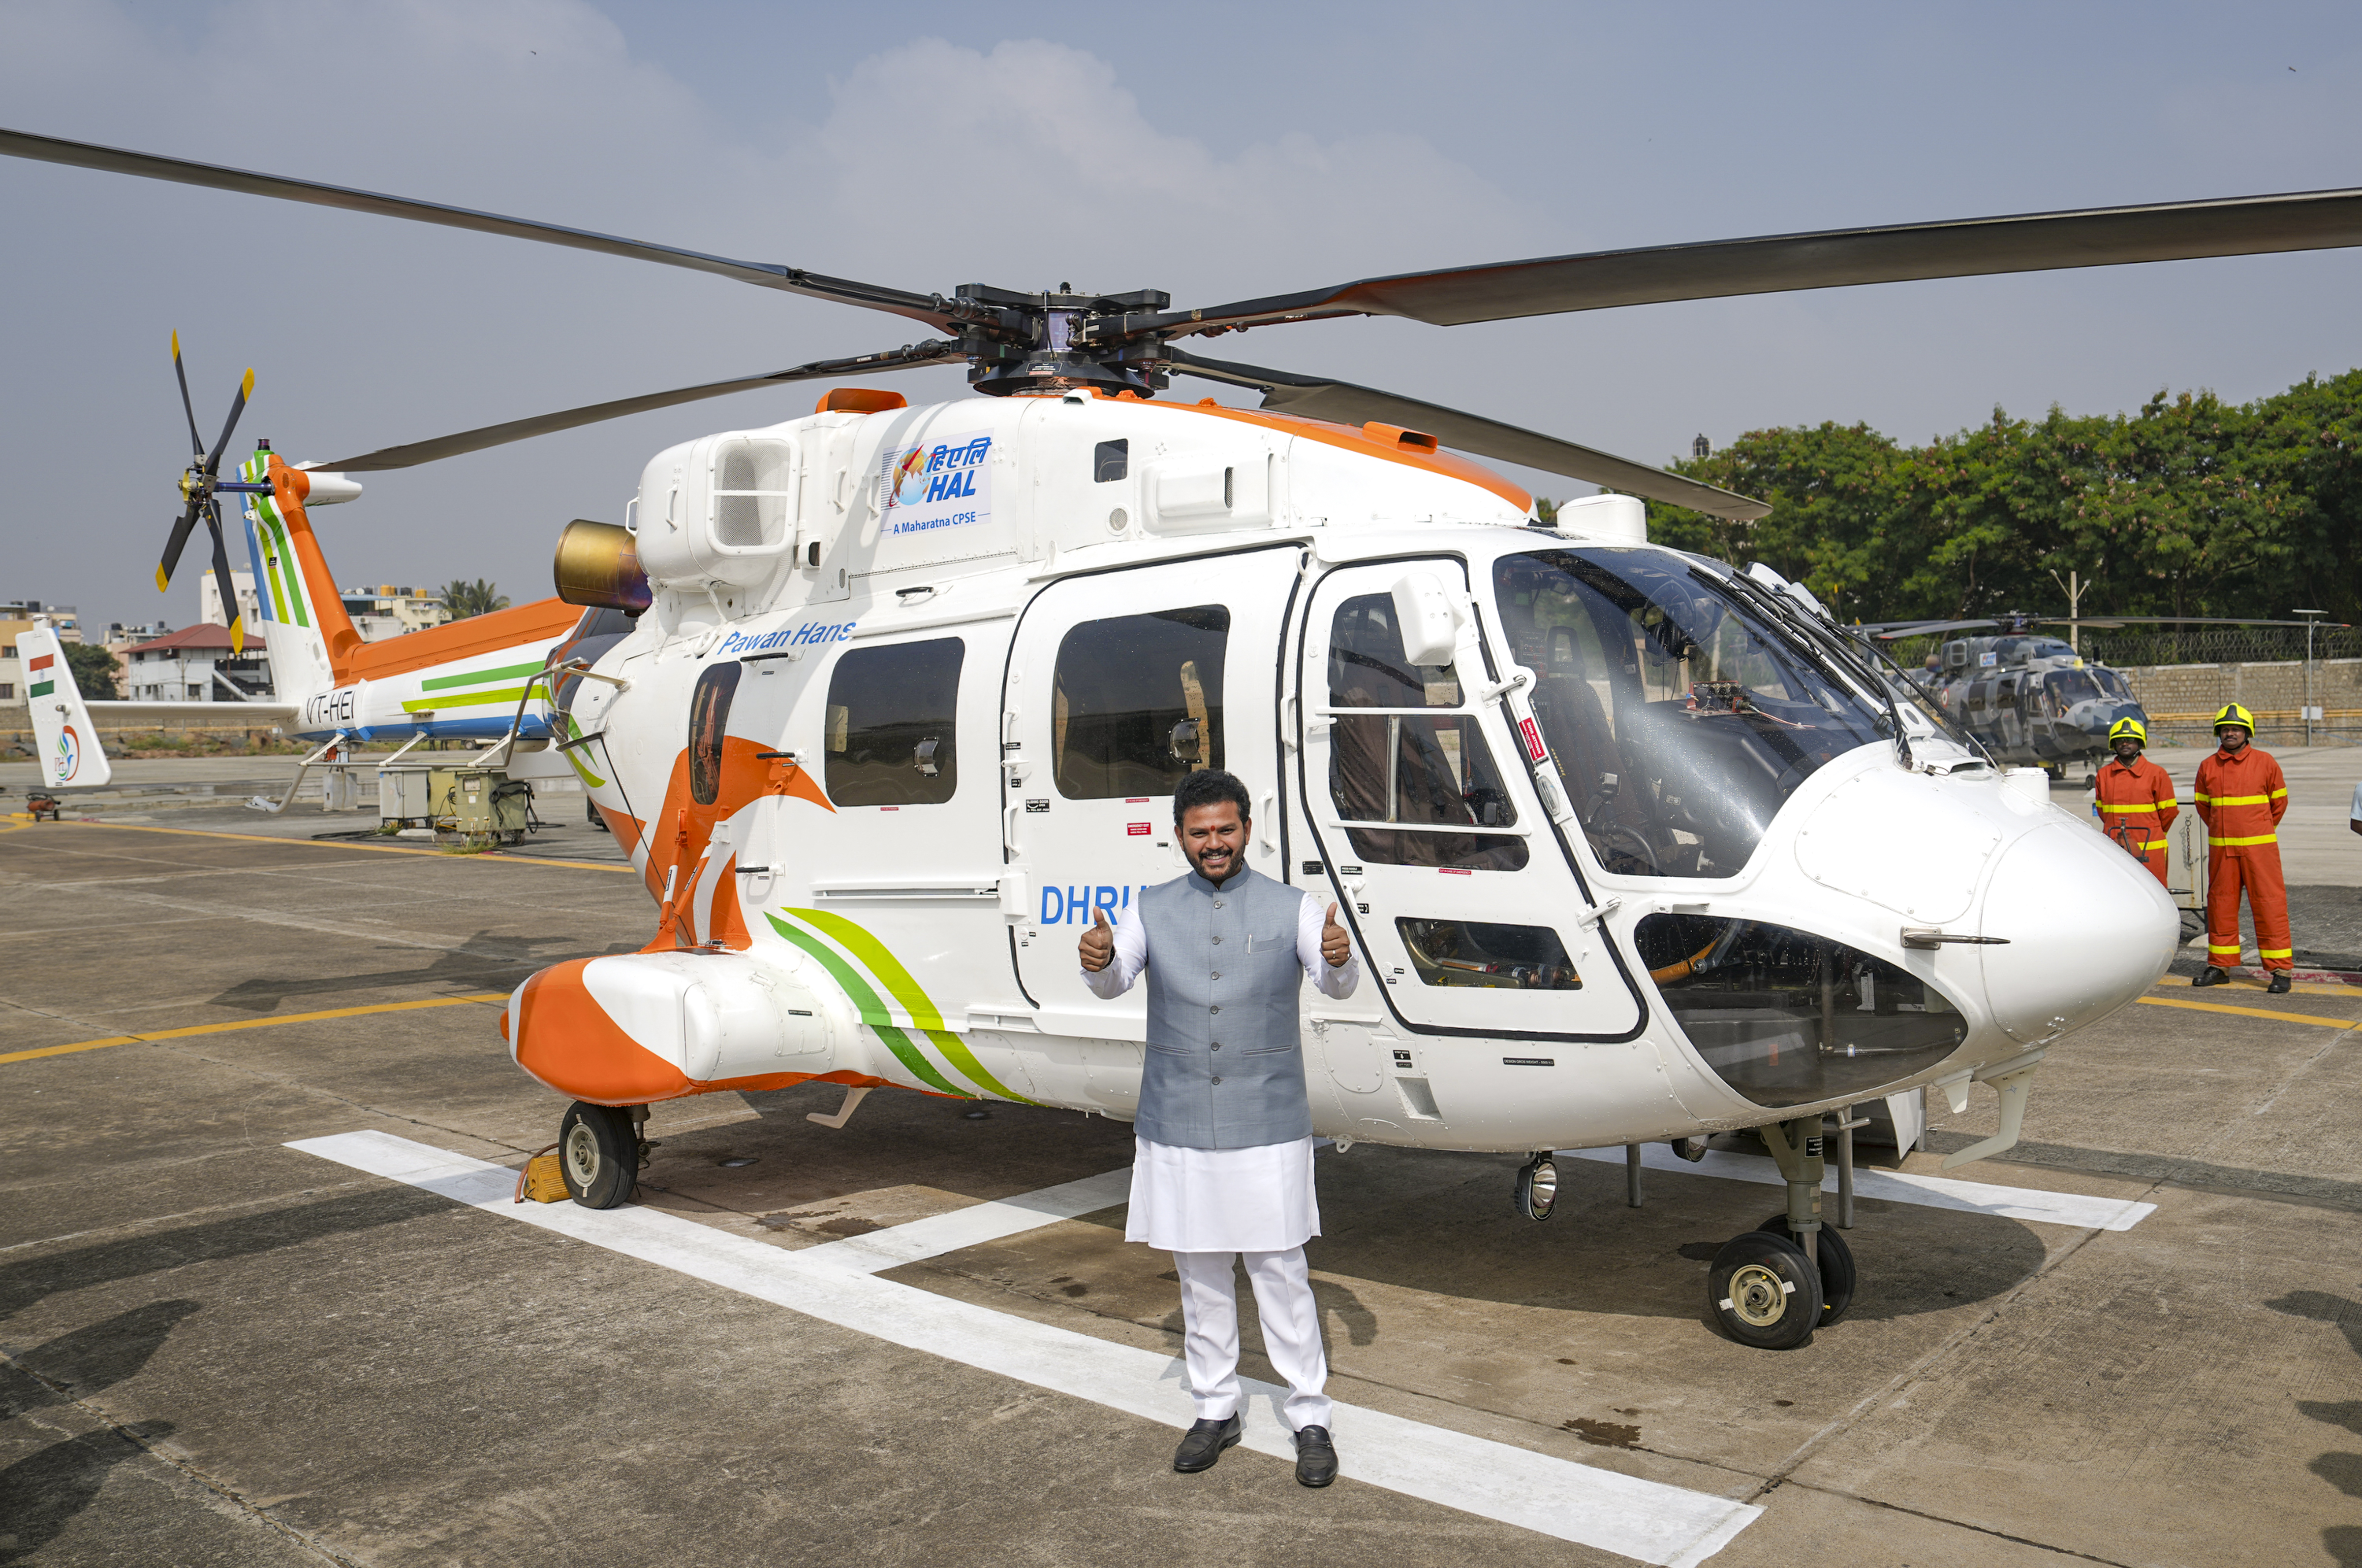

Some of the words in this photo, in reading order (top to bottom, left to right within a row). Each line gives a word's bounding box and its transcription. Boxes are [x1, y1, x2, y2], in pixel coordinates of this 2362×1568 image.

[926, 470, 976, 503] HAL
[893, 523, 900, 535] A
[901, 518, 950, 533] Maharatna
[952, 511, 976, 524] CPSE
[716, 630, 792, 655] Pawan
[790, 622, 856, 646] Hans
[307, 690, 355, 724] VT-HEI
[1531, 734, 1542, 755] JETTISON
